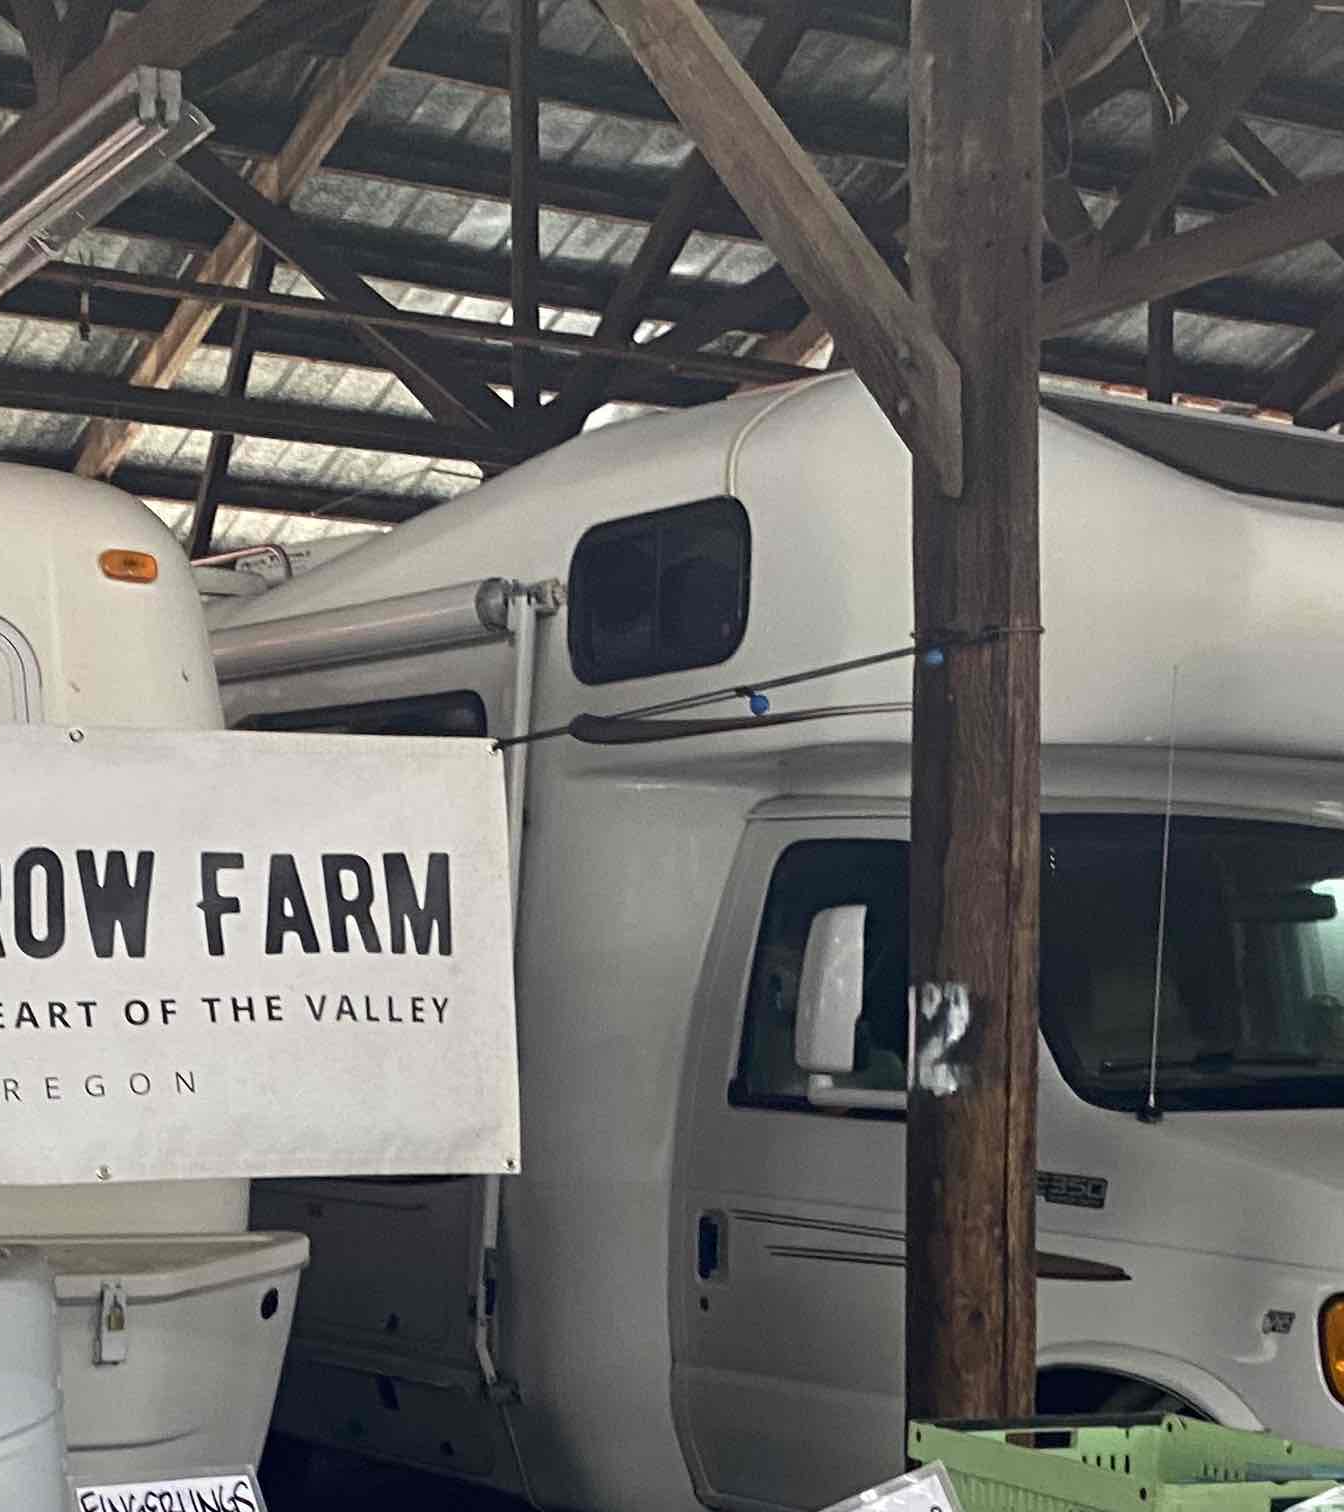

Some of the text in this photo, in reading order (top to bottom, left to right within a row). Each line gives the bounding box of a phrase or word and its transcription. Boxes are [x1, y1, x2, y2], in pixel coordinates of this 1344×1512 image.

[197, 851, 453, 957] FARM
[124, 998, 177, 1026] OF
[201, 996, 283, 1023] THE
[309, 995, 451, 1024] VALLEY
